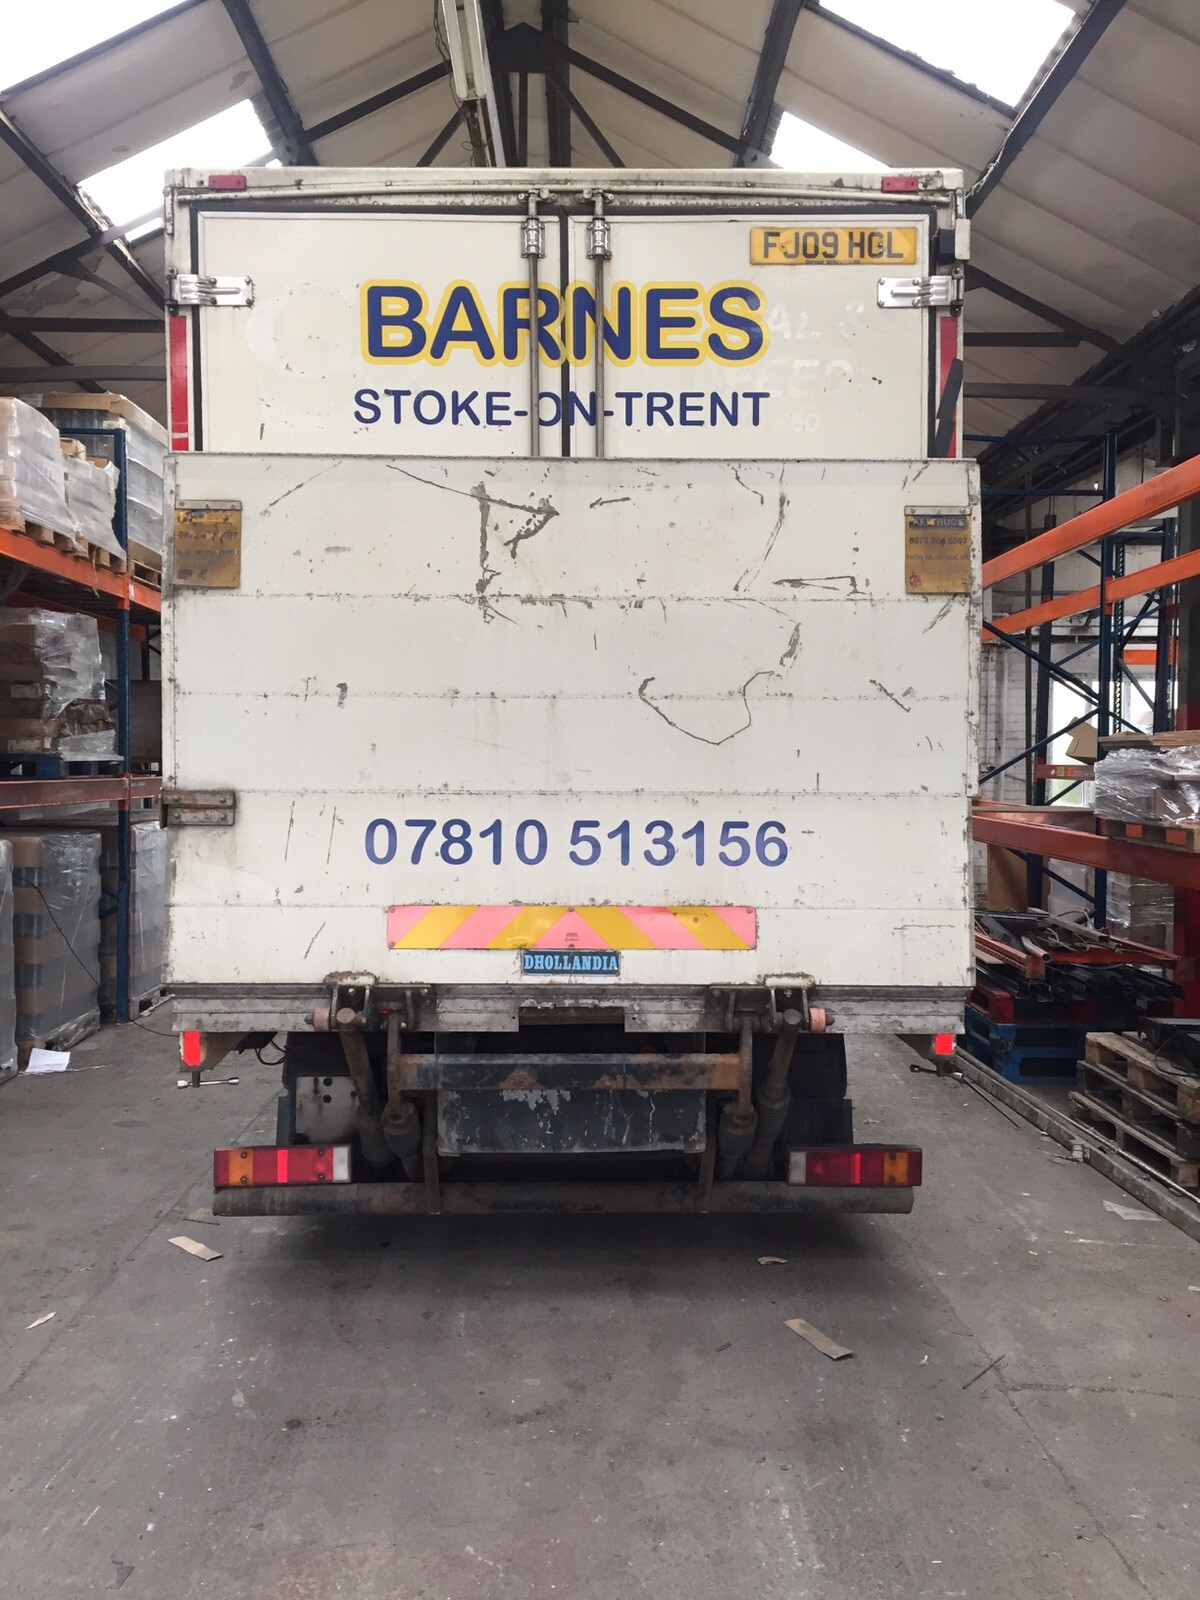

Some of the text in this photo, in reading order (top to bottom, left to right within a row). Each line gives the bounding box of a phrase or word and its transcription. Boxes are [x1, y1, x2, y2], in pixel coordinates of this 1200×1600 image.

[763, 231, 839, 259] FJ09
[361, 280, 769, 366] BARNES
[354, 388, 771, 427] STOKE-ON-TRENT
[364, 818, 789, 867] 07810 513156
[524, 954, 619, 971] DHOLLANDIA
